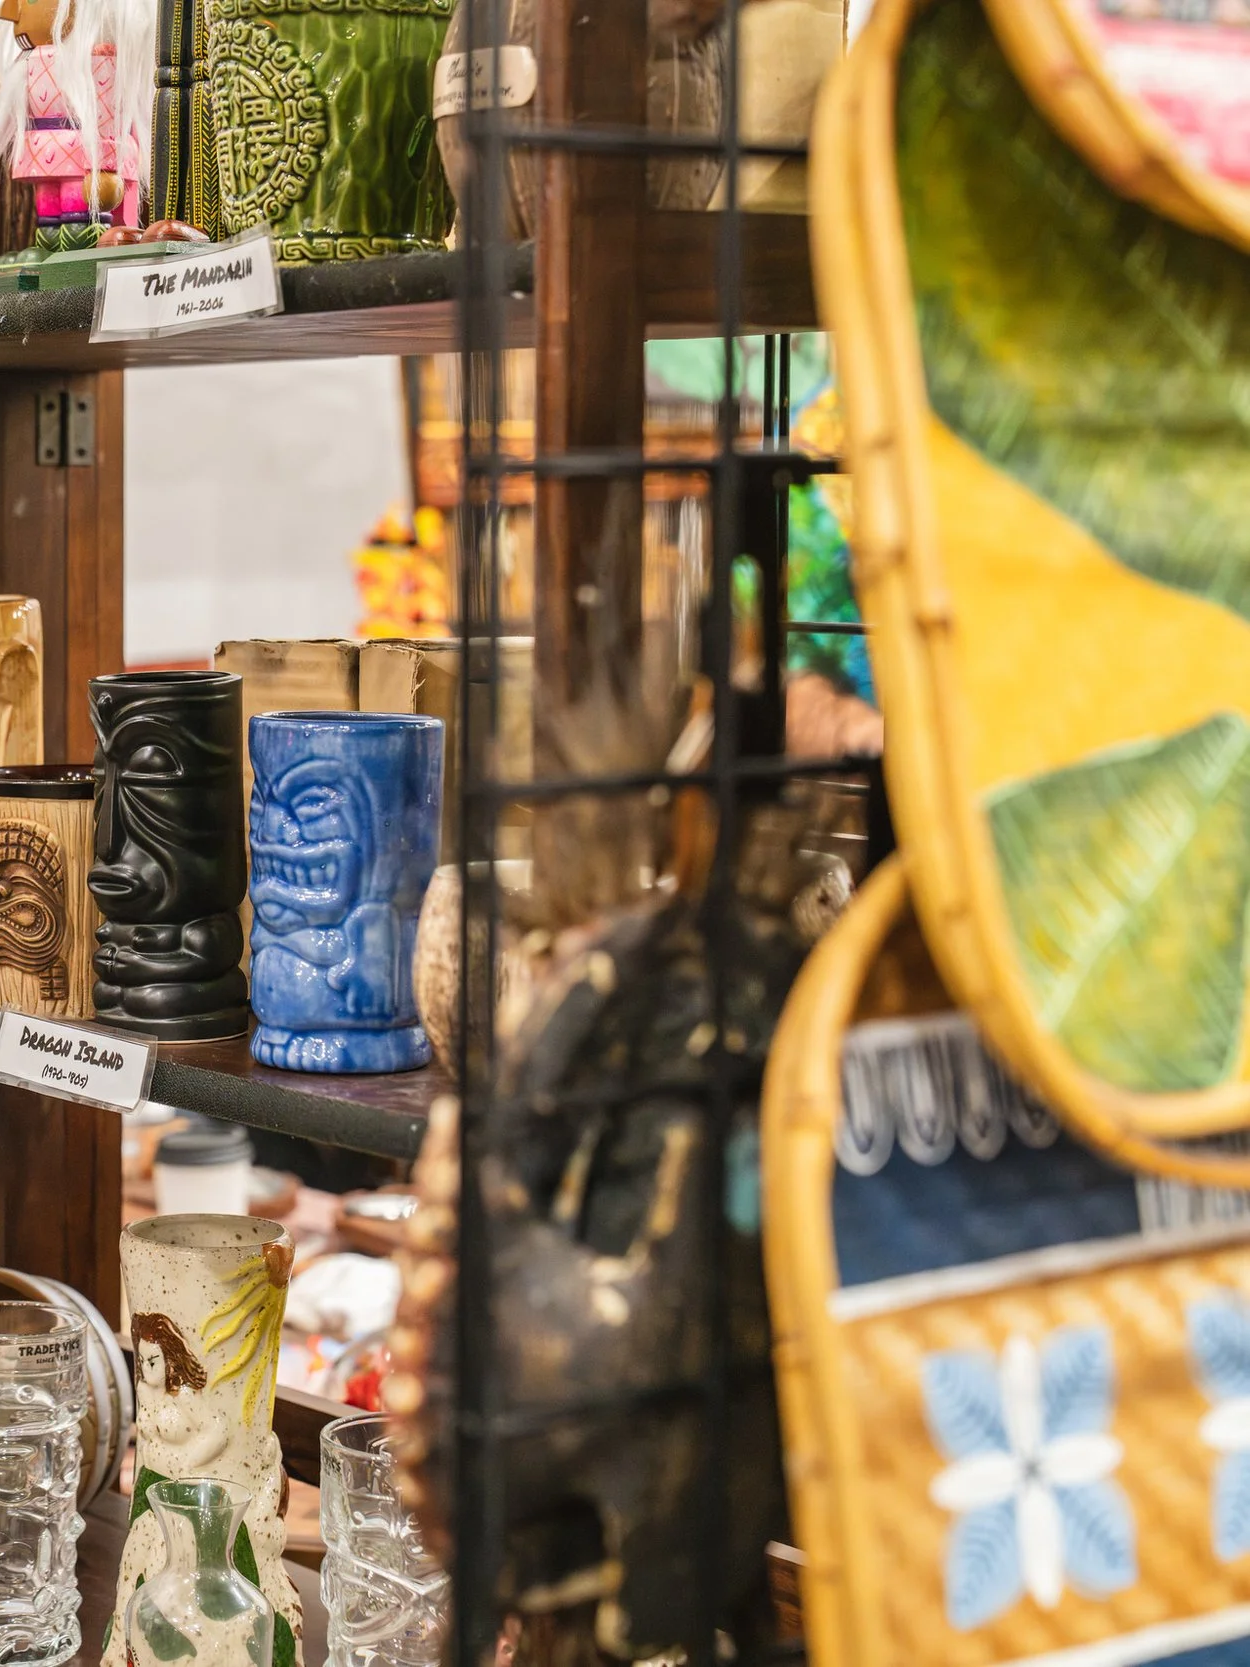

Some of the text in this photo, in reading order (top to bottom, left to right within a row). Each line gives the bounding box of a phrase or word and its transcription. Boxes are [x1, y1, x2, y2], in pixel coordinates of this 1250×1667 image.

[142, 257, 252, 296] THE MANDARIN
[176, 296, 224, 317] 1961-2006
[20, 1025, 124, 1071] DRAGON ISLAND
[18, 1342, 61, 1357] TRADER
